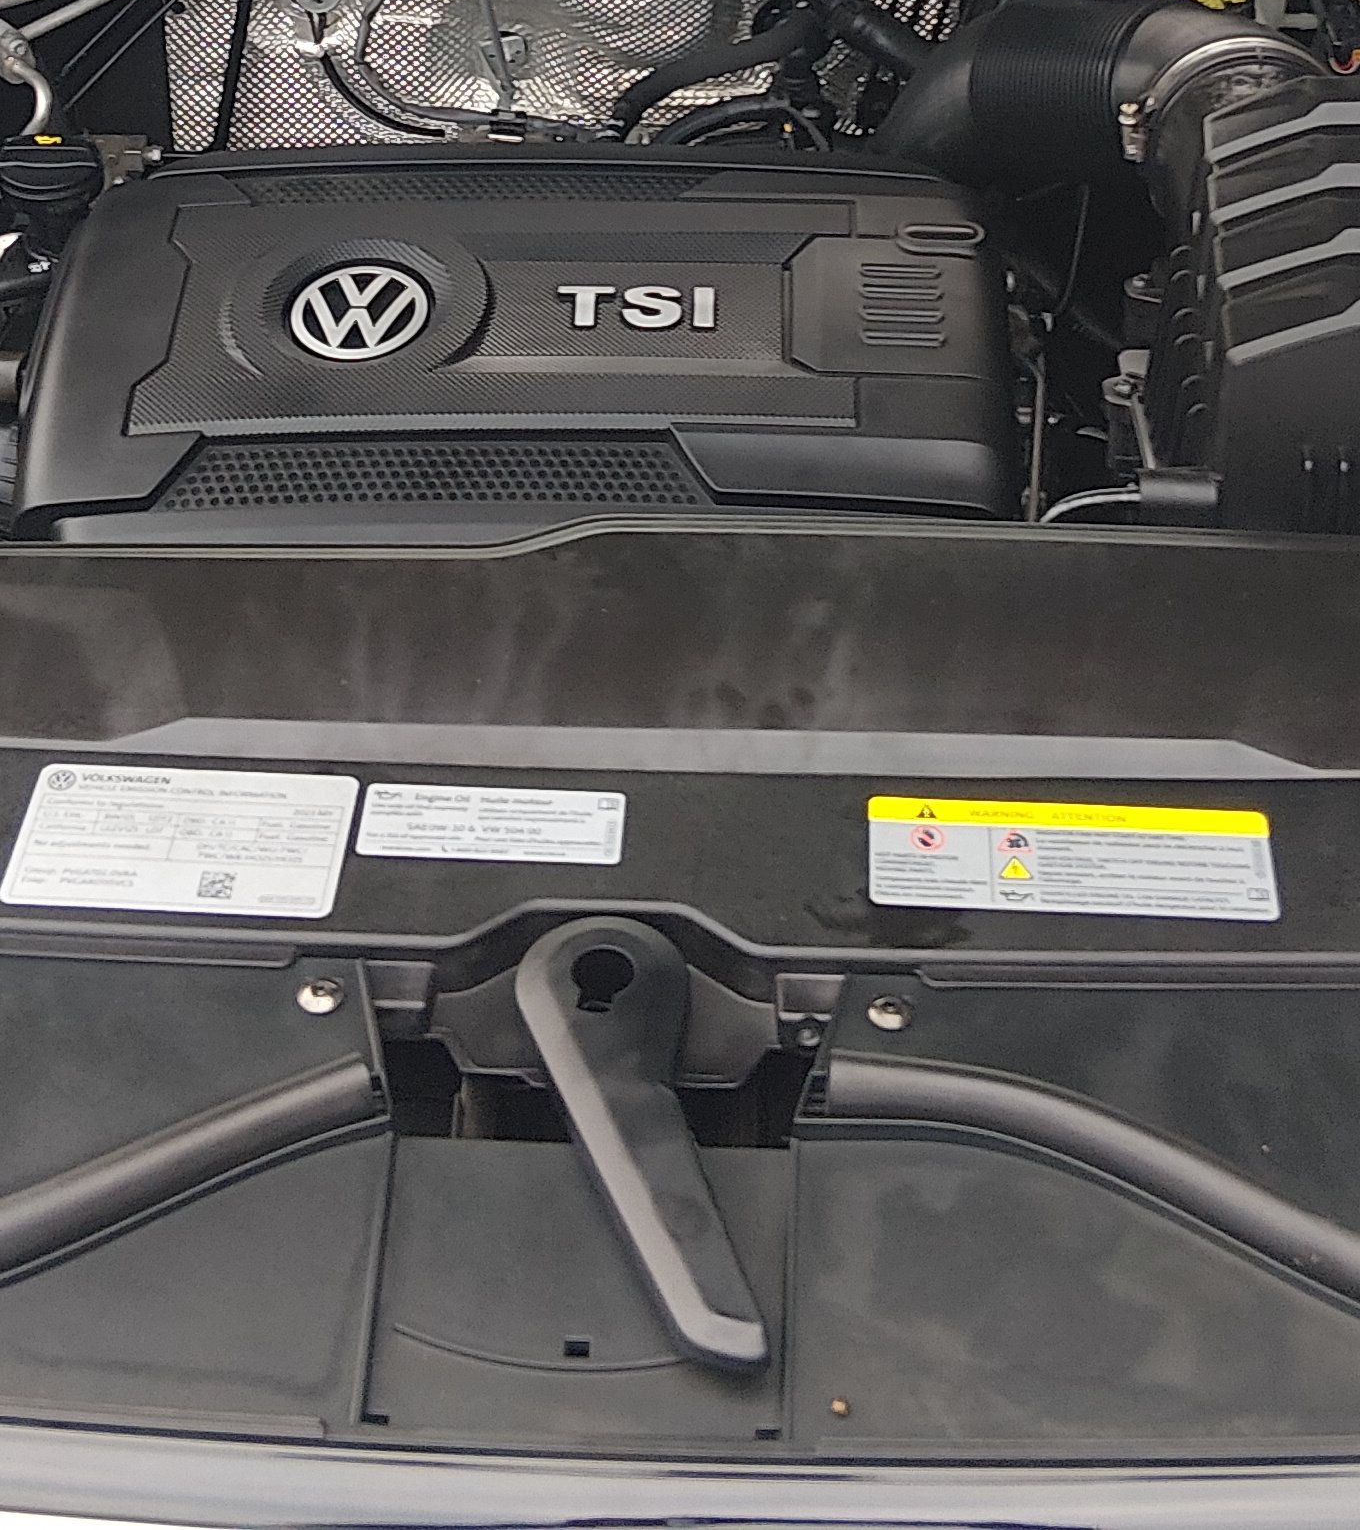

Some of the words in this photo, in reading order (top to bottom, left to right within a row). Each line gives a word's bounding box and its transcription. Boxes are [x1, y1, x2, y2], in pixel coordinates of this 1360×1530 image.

[557, 284, 716, 329] TSI
[82, 773, 172, 785] VOLKSWAGEN
[968, 809, 1034, 820] WARNING
[1051, 811, 1127, 823] ATTENTION
